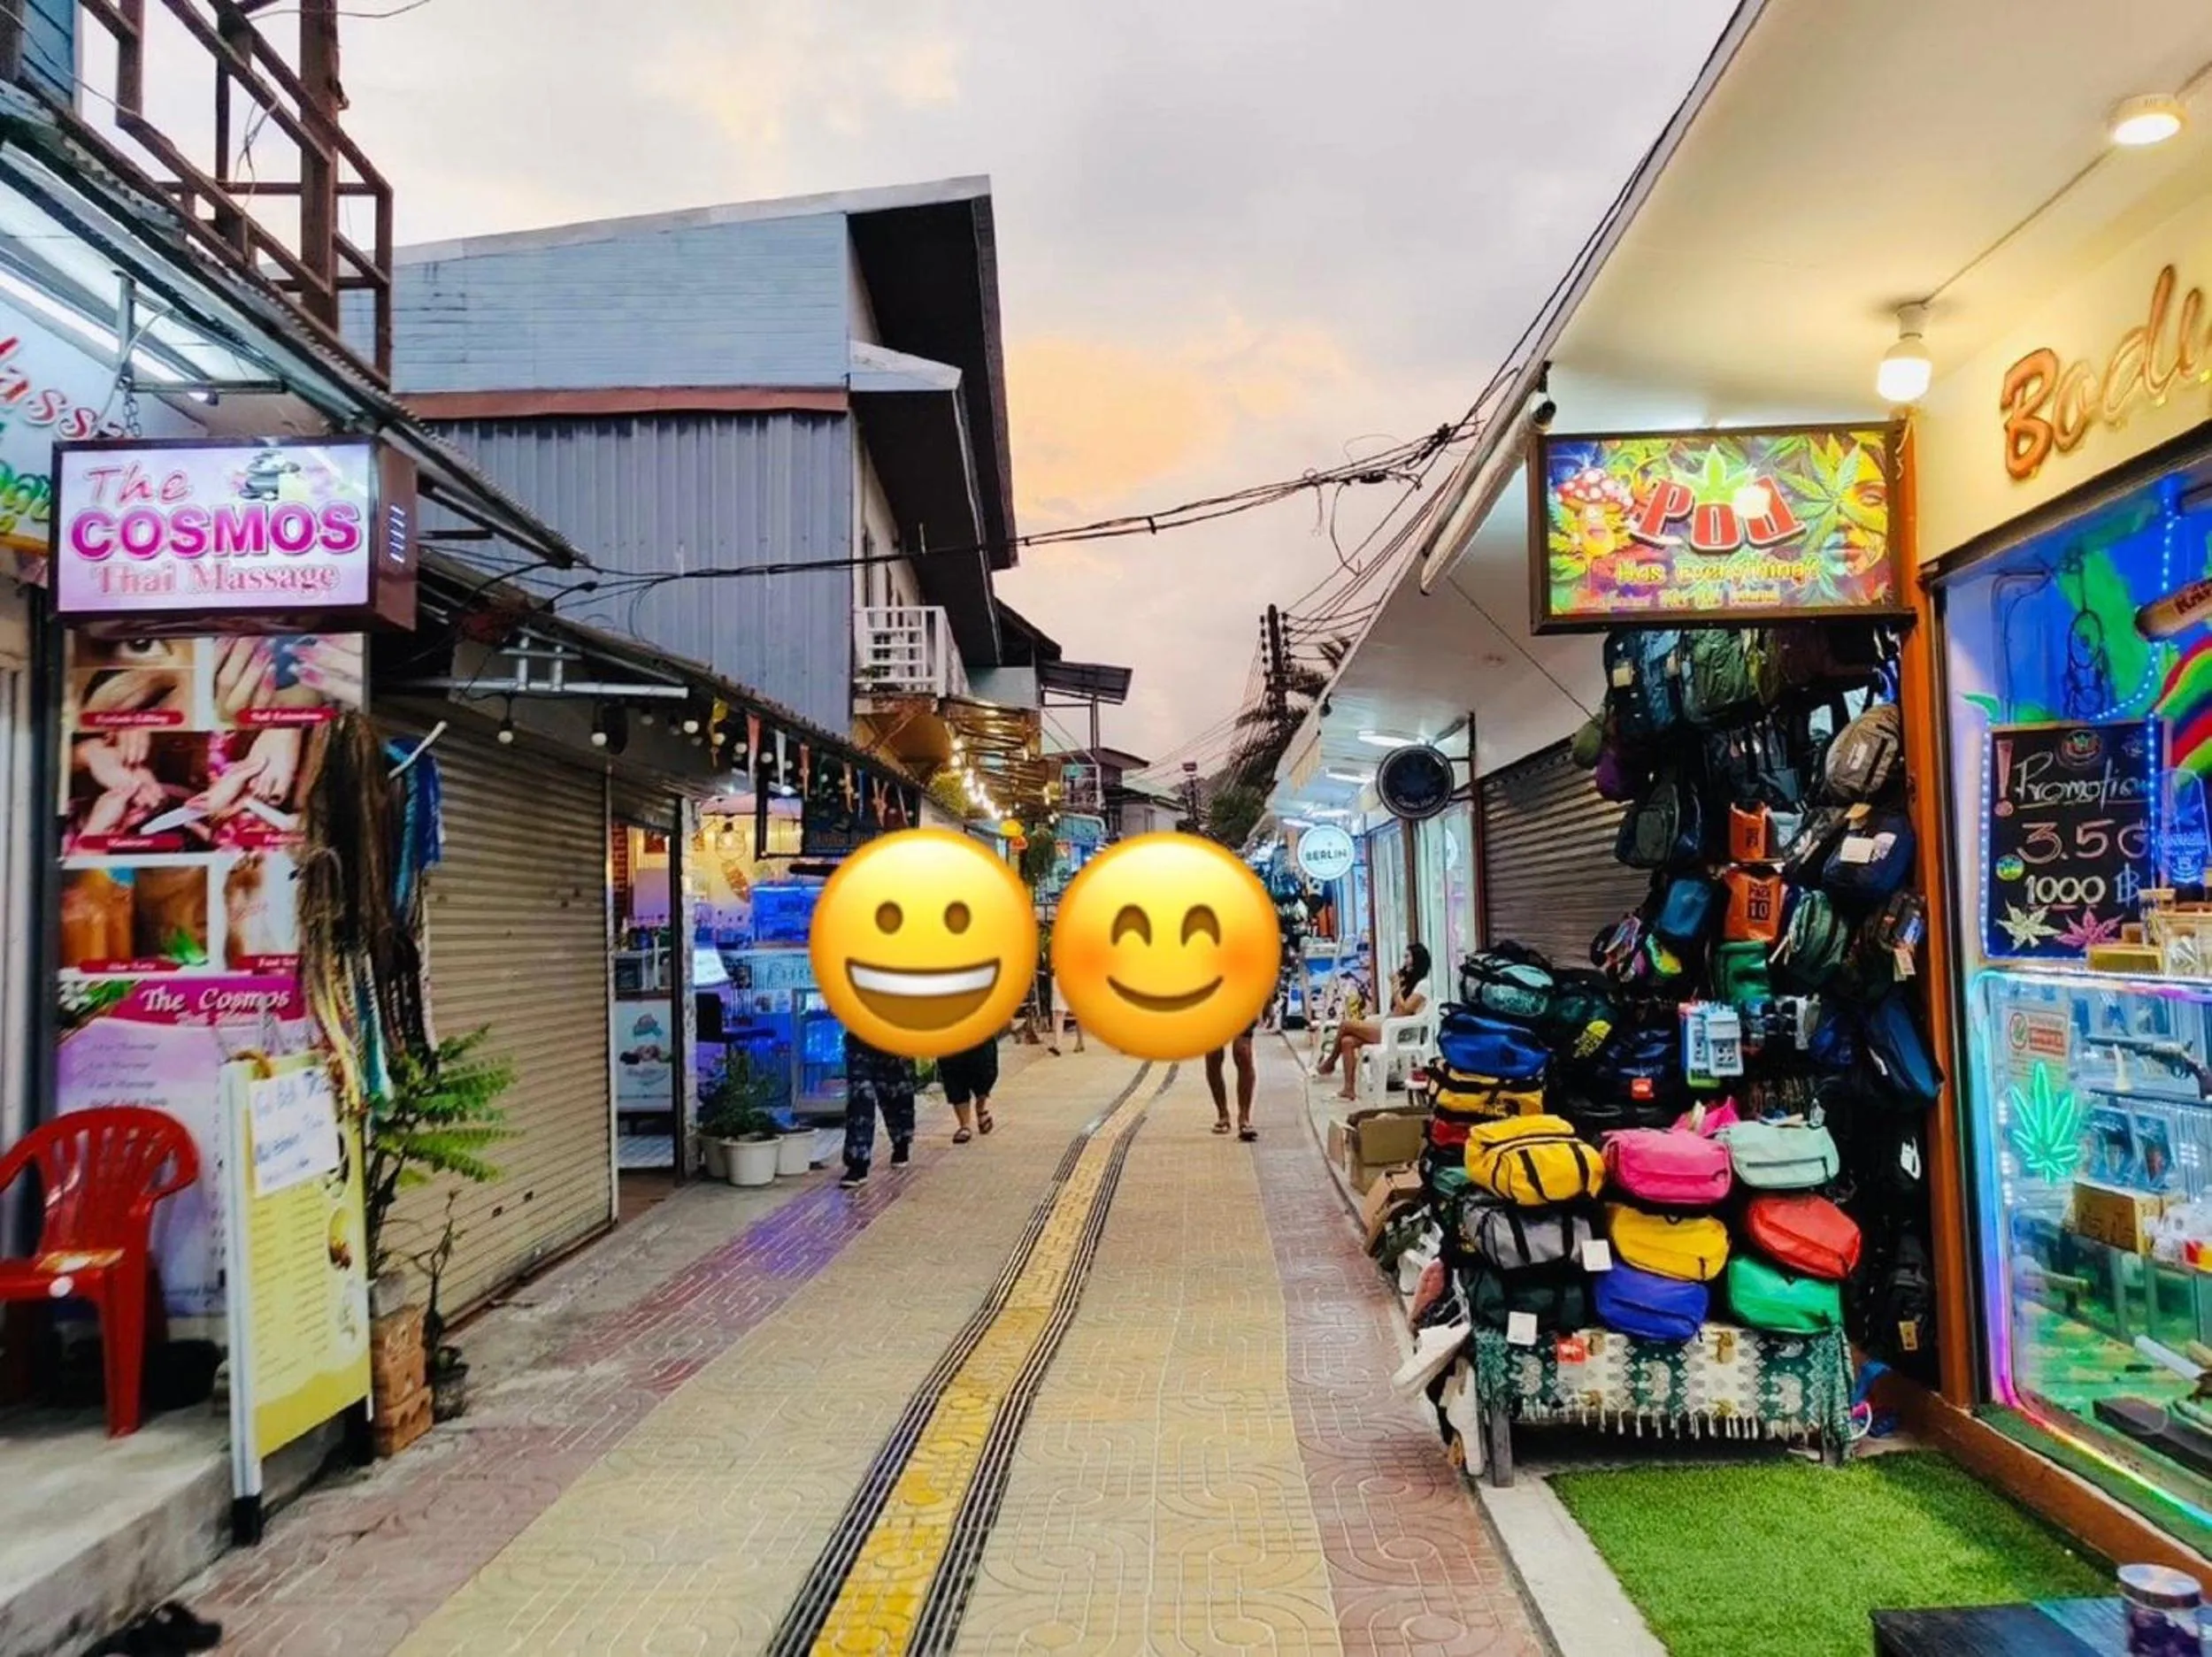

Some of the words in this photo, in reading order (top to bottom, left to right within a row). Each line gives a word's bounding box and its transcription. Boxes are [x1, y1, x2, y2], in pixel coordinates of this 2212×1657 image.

[85, 461, 192, 504] The
[71, 502, 361, 560] COSMOS
[95, 564, 174, 593] Thai
[188, 561, 341, 595] Massage
[1305, 848, 1348, 862] BERLIN
[2024, 875, 2106, 905] 1000
[141, 986, 186, 1012] The
[197, 986, 291, 1012] Cosmos
